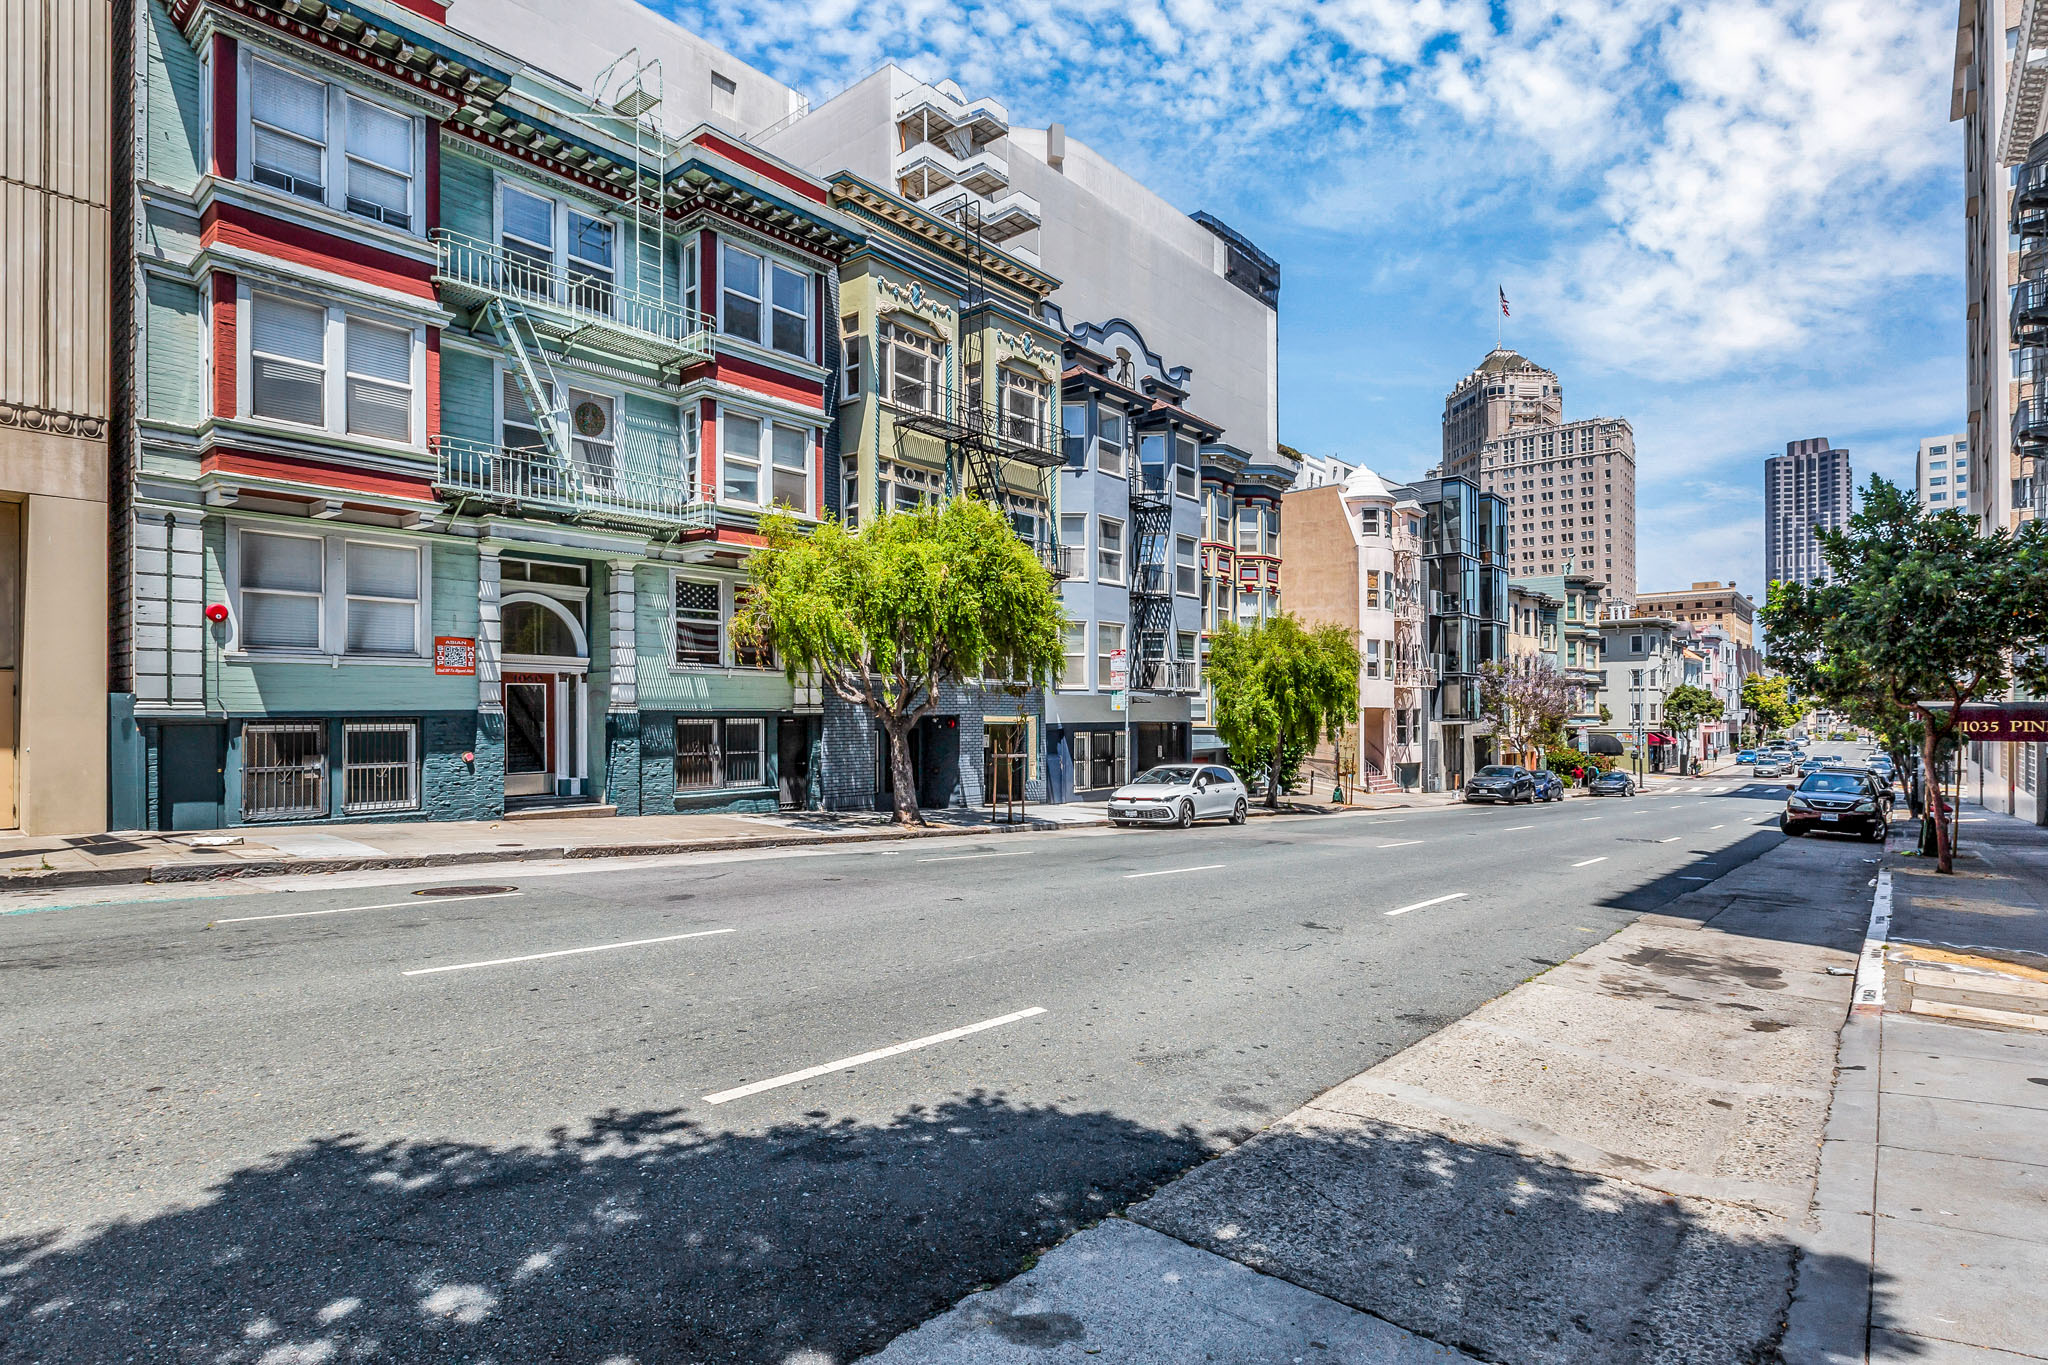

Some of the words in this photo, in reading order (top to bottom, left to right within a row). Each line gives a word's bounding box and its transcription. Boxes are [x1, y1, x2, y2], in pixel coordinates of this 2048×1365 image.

[467, 646, 475, 667] HATE
[1961, 721, 1999, 732] 1035
[2009, 720, 2048, 733] PIN
